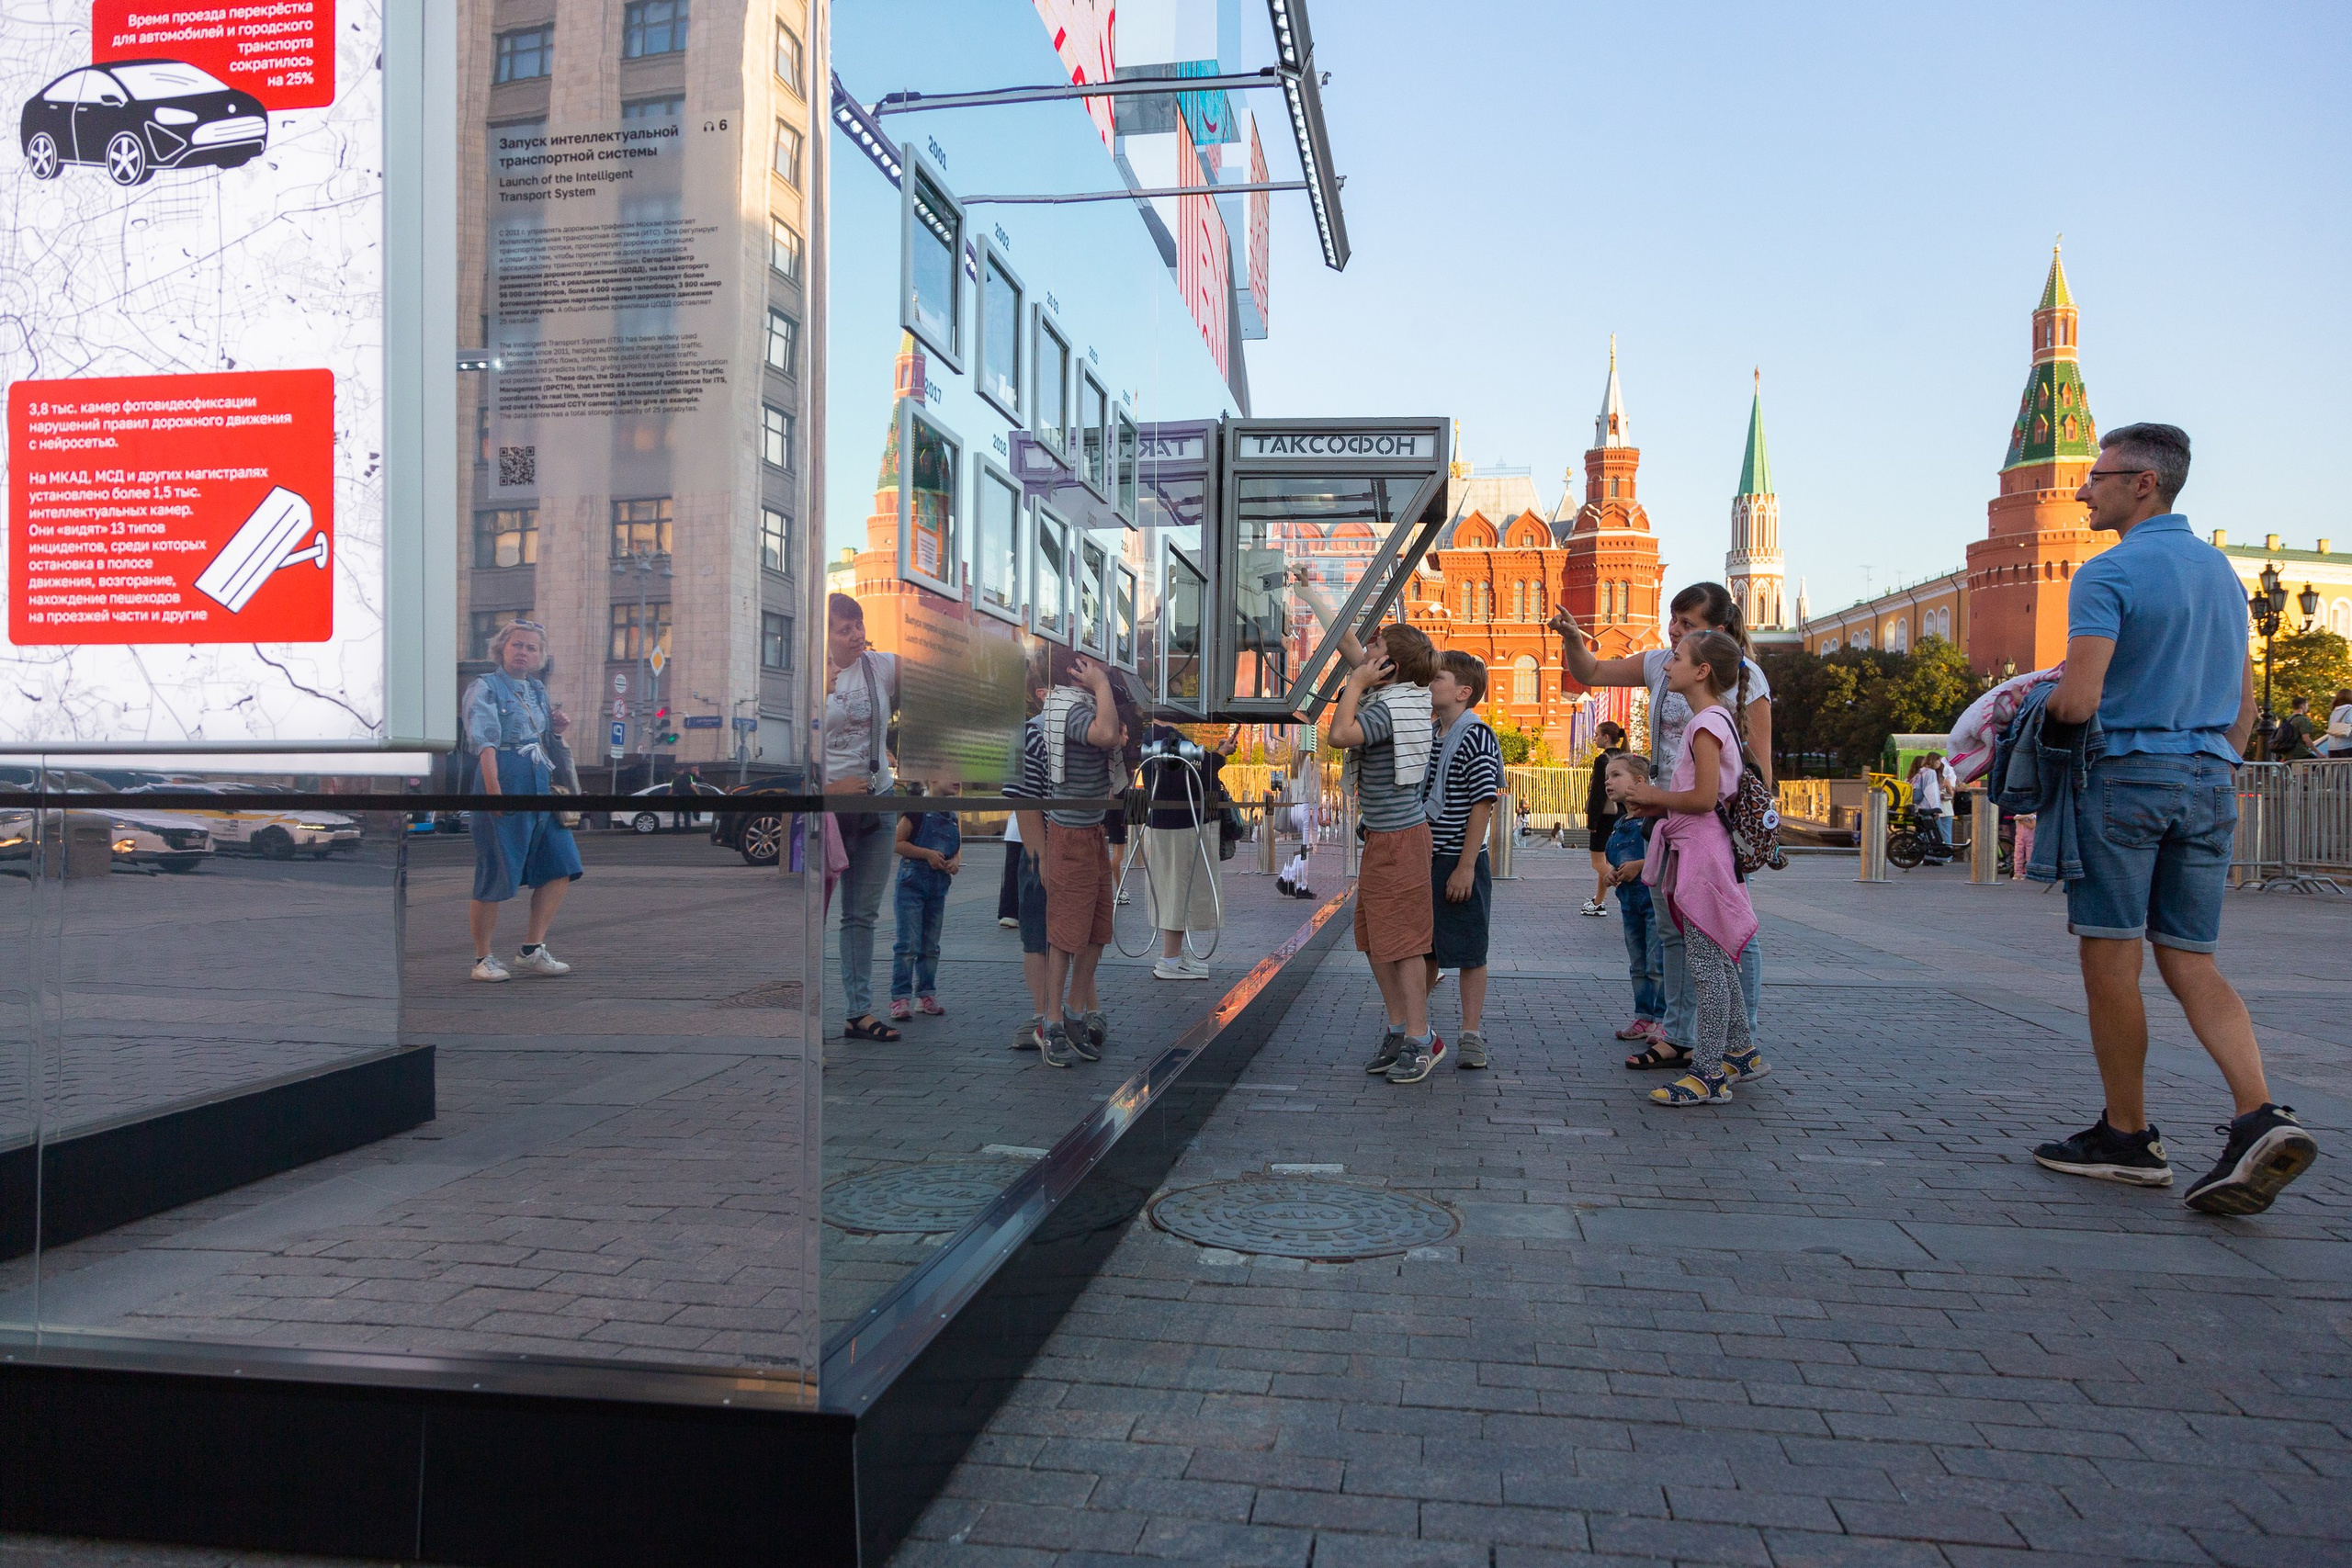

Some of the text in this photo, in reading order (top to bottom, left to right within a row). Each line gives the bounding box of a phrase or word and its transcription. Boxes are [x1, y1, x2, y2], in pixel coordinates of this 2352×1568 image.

[128, 3, 312, 28] Время проезда перекрёстка
[112, 21, 312, 46] для автомобилей и городского
[237, 39, 312, 54] транспорта
[230, 57, 312, 72] сократилось
[267, 73, 313, 85] на 25%
[718, 119, 728, 130] 6
[499, 128, 679, 151] Запуск интеллектуальной
[499, 147, 657, 169] транспортной системы
[928, 134, 946, 172] 2001
[499, 169, 633, 187] Launch of the Intelligent
[499, 187, 595, 201] Transport System
[995, 221, 1009, 252] 2002
[924, 377, 942, 405] 2017
[28, 398, 256, 416] 3,8 тыс. камер фотовидеофиксации
[28, 413, 291, 434] нарушений правил дорожного движения
[28, 437, 118, 450] с нейросетью.
[993, 434, 1007, 457] 2018
[1253, 435, 1415, 456] ТАКСОФОН
[29, 468, 267, 484] На МКАД, МСД и других магистралях
[28, 487, 200, 503] установлено более 1,5 тыс.
[28, 505, 193, 518] интеллектуальных камер.
[28, 523, 165, 536] Они «видят» 13 типов
[28, 540, 206, 553] инцидентов, среди которых
[28, 558, 153, 570] остановка в полосе
[28, 576, 175, 589] движения, возгорание,
[28, 593, 180, 605] нахождение пешеходов
[28, 610, 207, 624] на проезжей части и другие
